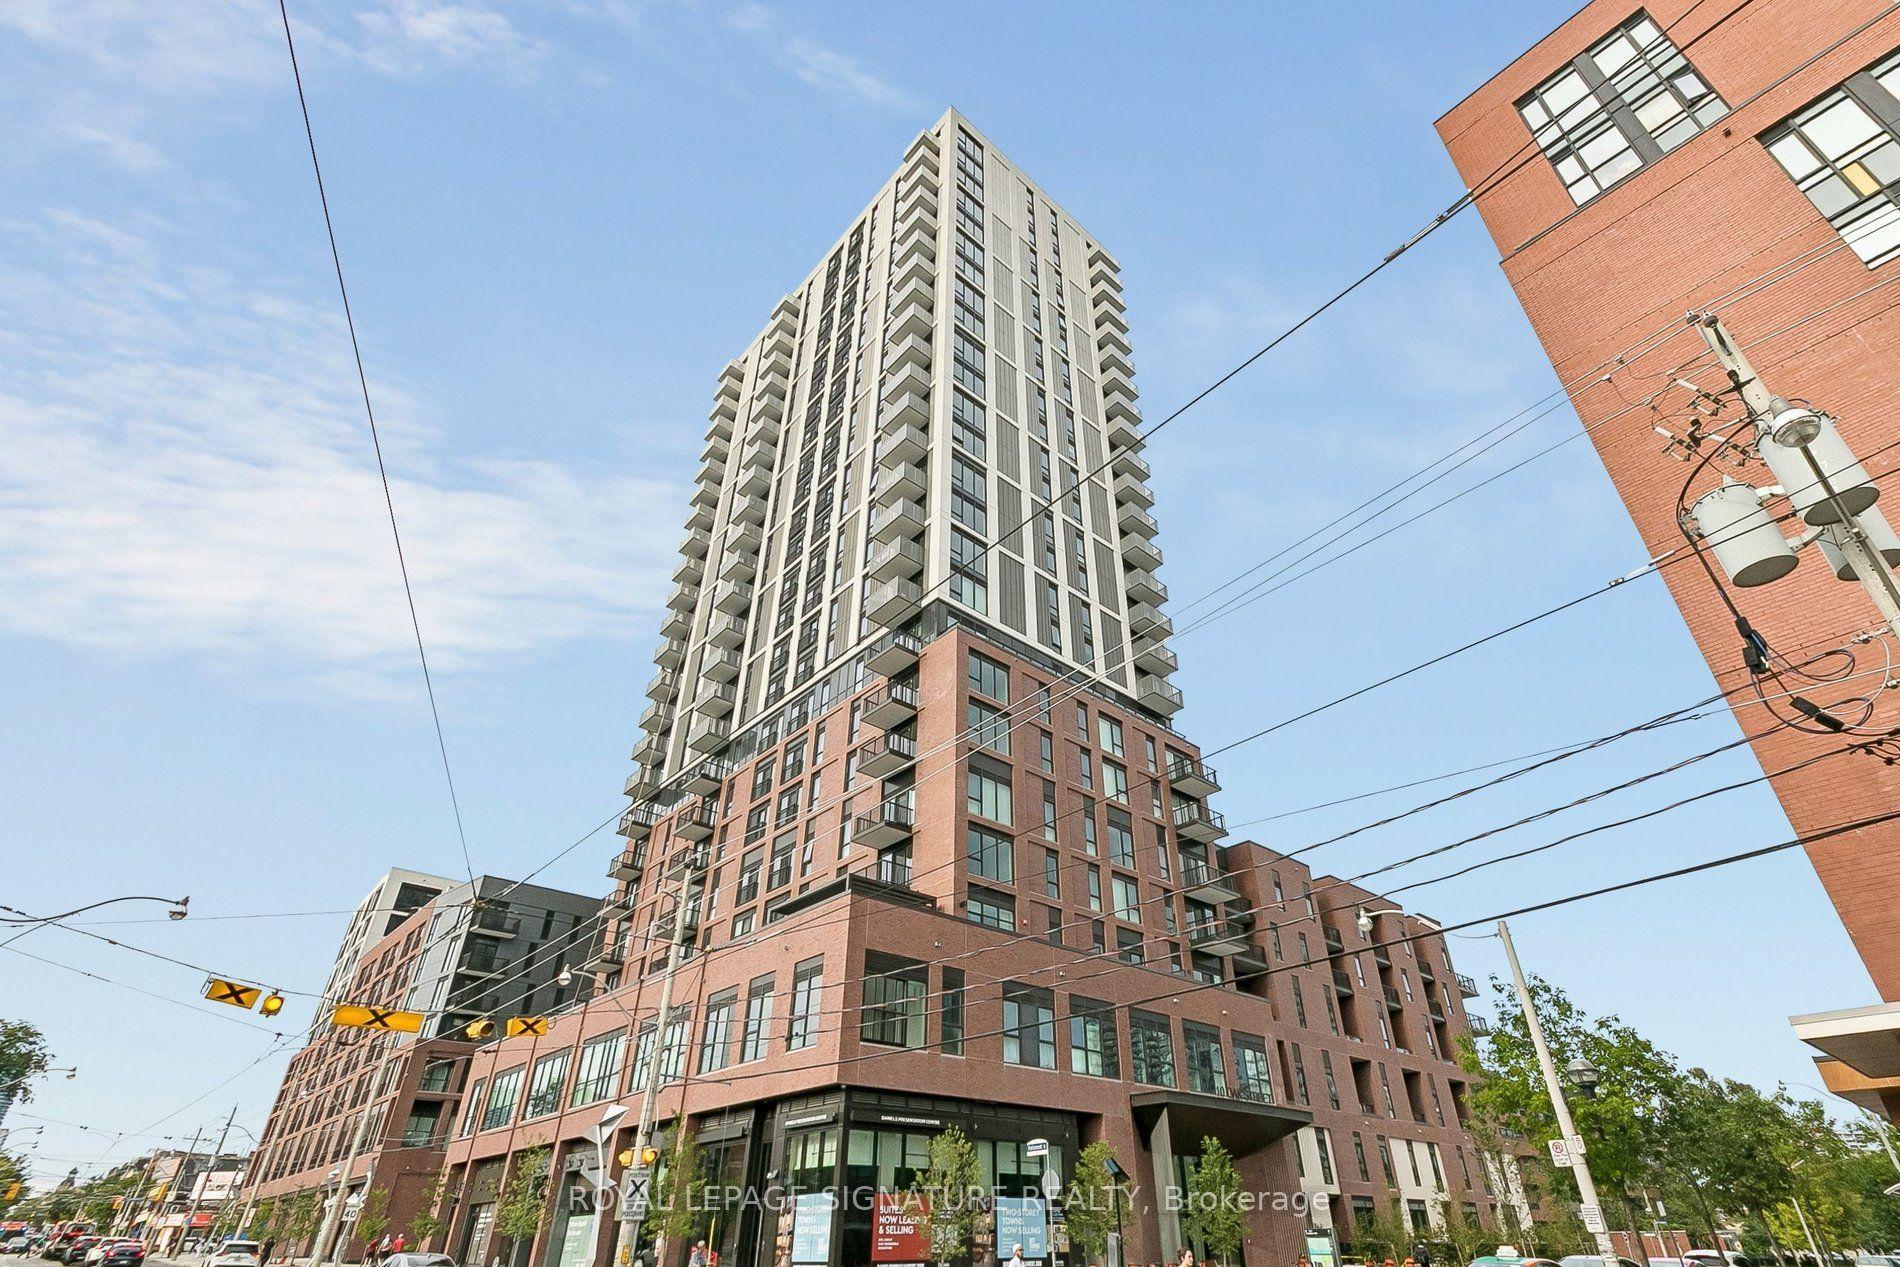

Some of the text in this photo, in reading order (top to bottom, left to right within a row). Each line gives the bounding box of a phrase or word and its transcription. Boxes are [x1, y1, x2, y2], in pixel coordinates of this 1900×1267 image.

[344, 1210, 357, 1218] 40
[879, 1205, 903, 1214] SUITES
[1002, 1208, 1040, 1216] TWO-STOREY
[879, 1215, 898, 1224] NOW
[878, 1225, 914, 1234] & SELLING
[1002, 1226, 1041, 1235] NOW SELLING
